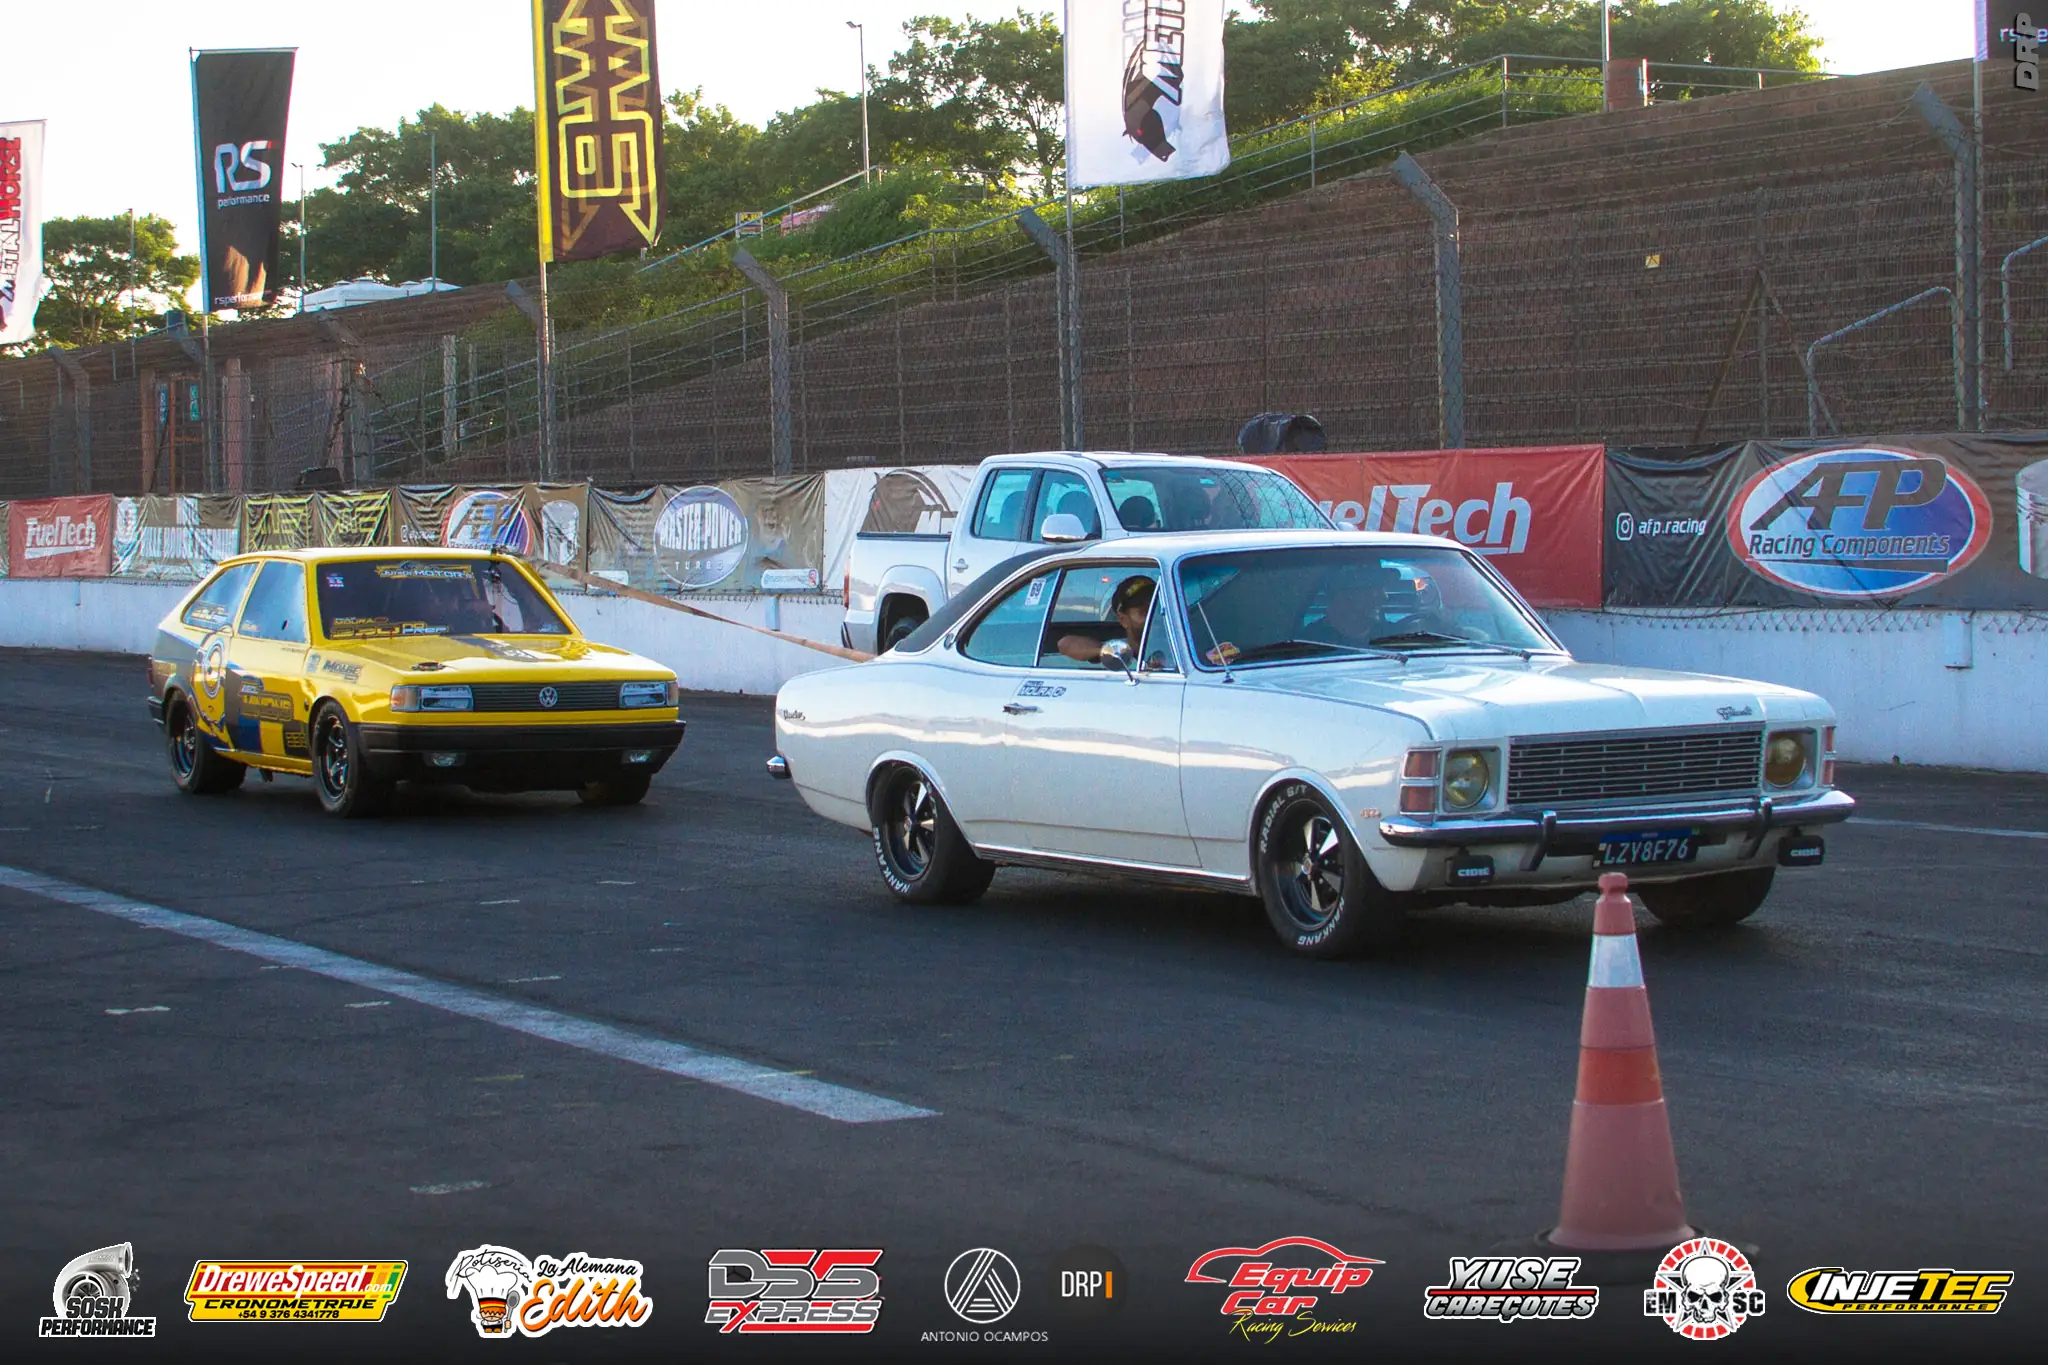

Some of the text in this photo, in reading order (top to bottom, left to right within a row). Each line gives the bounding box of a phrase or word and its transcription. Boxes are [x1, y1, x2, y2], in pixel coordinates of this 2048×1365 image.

[1750, 458, 1947, 531] AFP
[27, 515, 96, 549] FuelTech
[659, 502, 742, 551] MASTER POWER
[1318, 482, 1532, 553] elTech
[1638, 517, 1707, 536] afp.racing
[1750, 532, 1951, 559] Racing Components
[1259, 797, 1285, 854] RADIAL
[1603, 838, 1689, 865] LZY8F76
